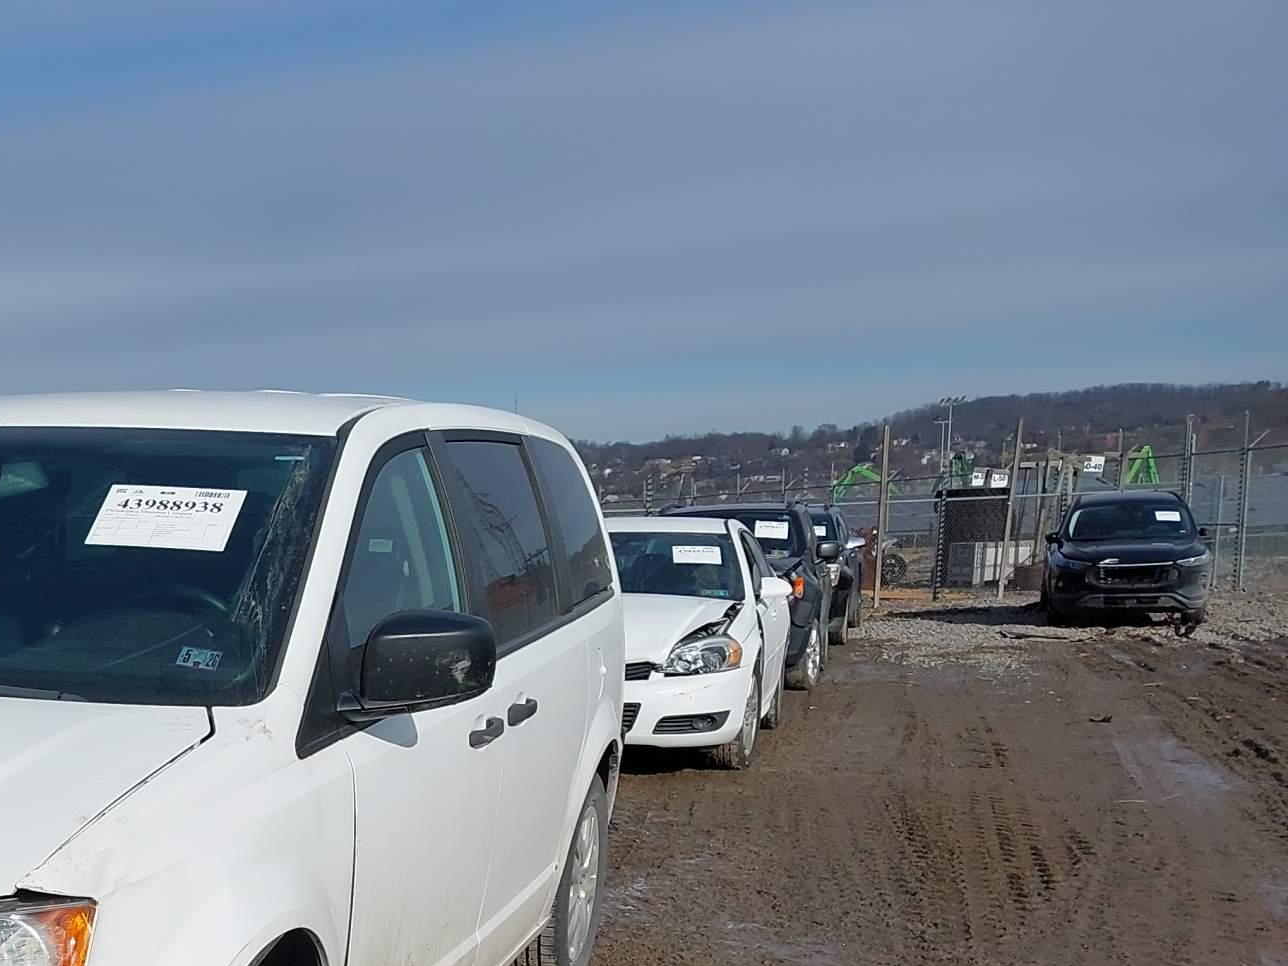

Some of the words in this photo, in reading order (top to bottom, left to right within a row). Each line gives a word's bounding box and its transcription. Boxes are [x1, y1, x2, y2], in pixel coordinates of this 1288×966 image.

[117, 498, 224, 513] 43988938
[183, 649, 193, 663] 5
[206, 653, 220, 667] 26
